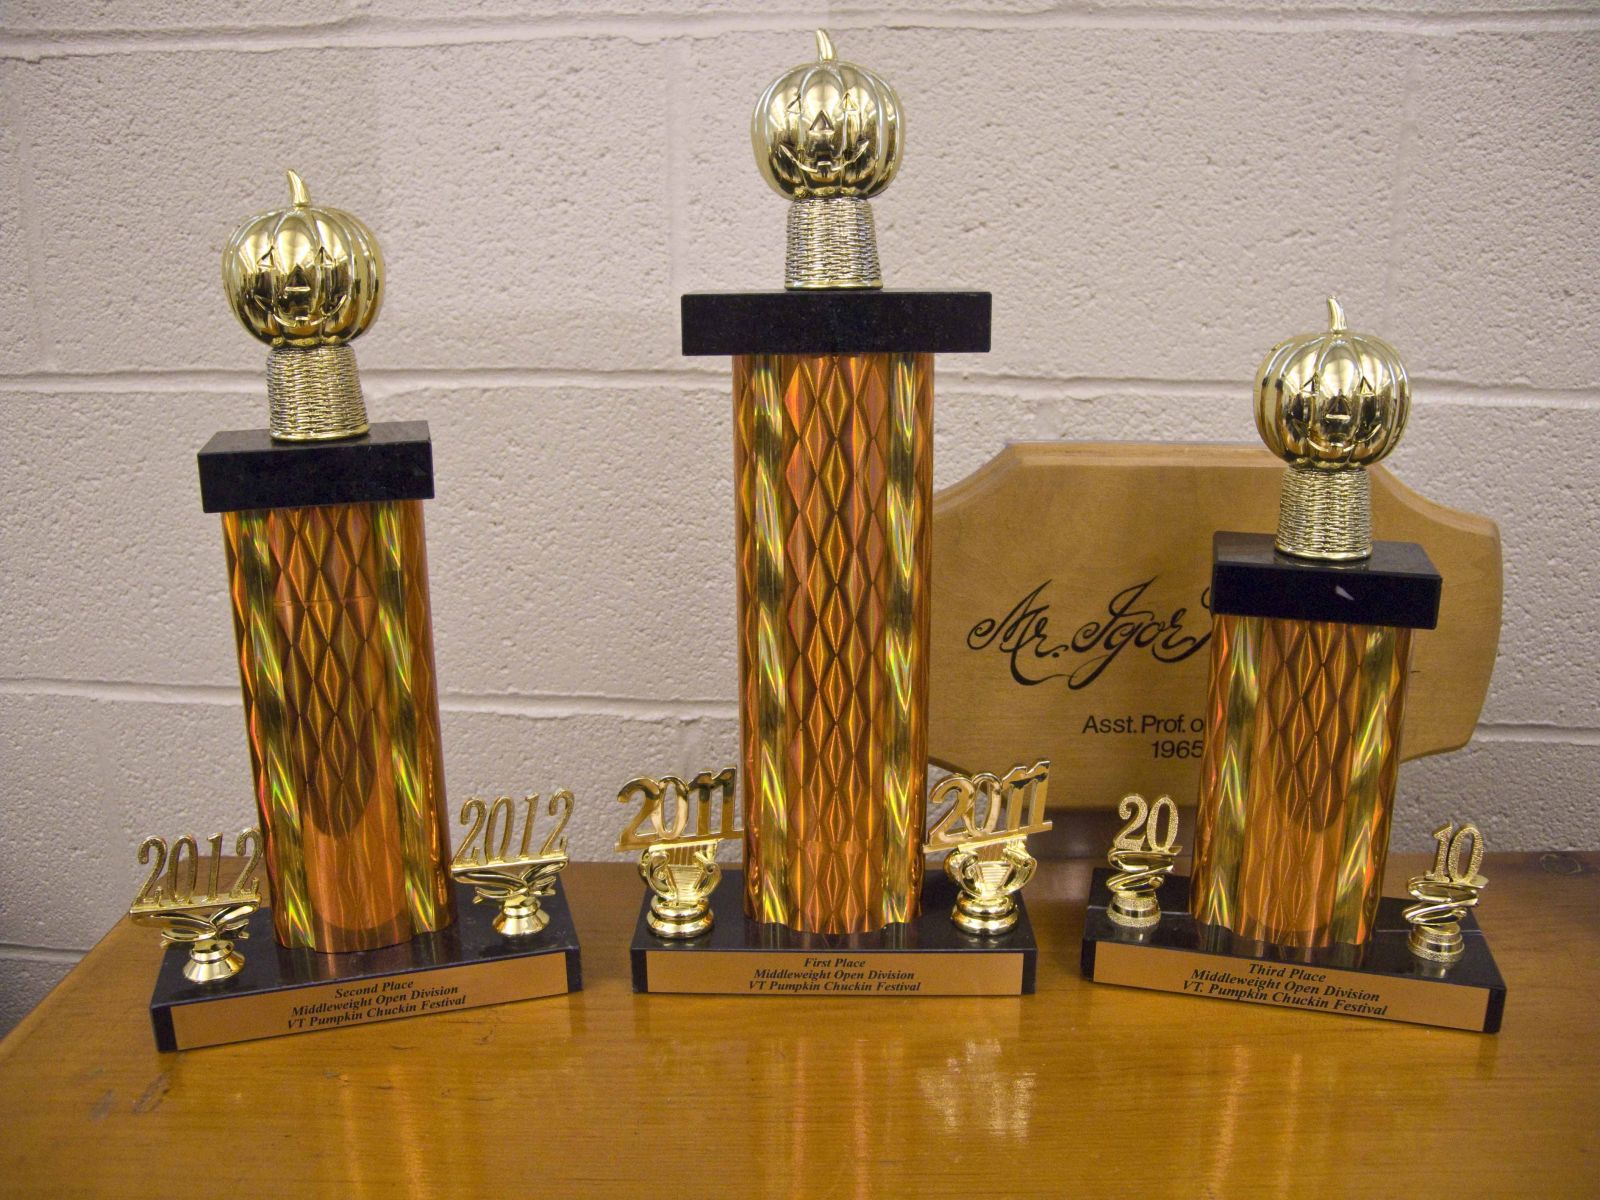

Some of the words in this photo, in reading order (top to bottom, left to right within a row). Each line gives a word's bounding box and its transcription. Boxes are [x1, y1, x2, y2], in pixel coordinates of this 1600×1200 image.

[967, 578, 1068, 686] Mr.
[1068, 575, 1198, 690] Igor
[1082, 714, 1137, 734] Asst.
[1141, 714, 1186, 734] Prof.
[617, 764, 738, 846] 2011
[929, 759, 1052, 846] 2011
[453, 787, 576, 867] 2012
[1113, 793, 1179, 852] 20
[131, 826, 264, 908] 2012
[1424, 821, 1484, 883] 10
[753, 968, 832, 981] Middleweight
[834, 969, 864, 981] Open
[867, 969, 915, 980] Division
[804, 957, 832, 968] First
[834, 957, 866, 968] Place
[1249, 963, 1287, 978] Third
[1289, 968, 1327, 983] Place
[291, 996, 372, 1017] Middleweight
[375, 992, 407, 1006] Open
[410, 985, 459, 1000] Division
[334, 983, 378, 1000] Second
[382, 979, 414, 993] Place
[749, 980, 766, 991] VT
[769, 980, 821, 993] Pumpkin
[824, 981, 872, 992] Chuckin
[876, 981, 921, 992] Festival
[1190, 968, 1281, 991] Middleweight
[1284, 980, 1319, 996] Open
[1323, 985, 1381, 1002] Division
[1208, 983, 1268, 1001] Pumpkin
[1272, 991, 1329, 1009] Chuckin
[1333, 1001, 1388, 1016] Festival
[288, 1016, 306, 1029] VT
[309, 1012, 363, 1027] Pumpkin
[366, 1004, 417, 1018] Chuckin
[420, 995, 466, 1010] Festival
